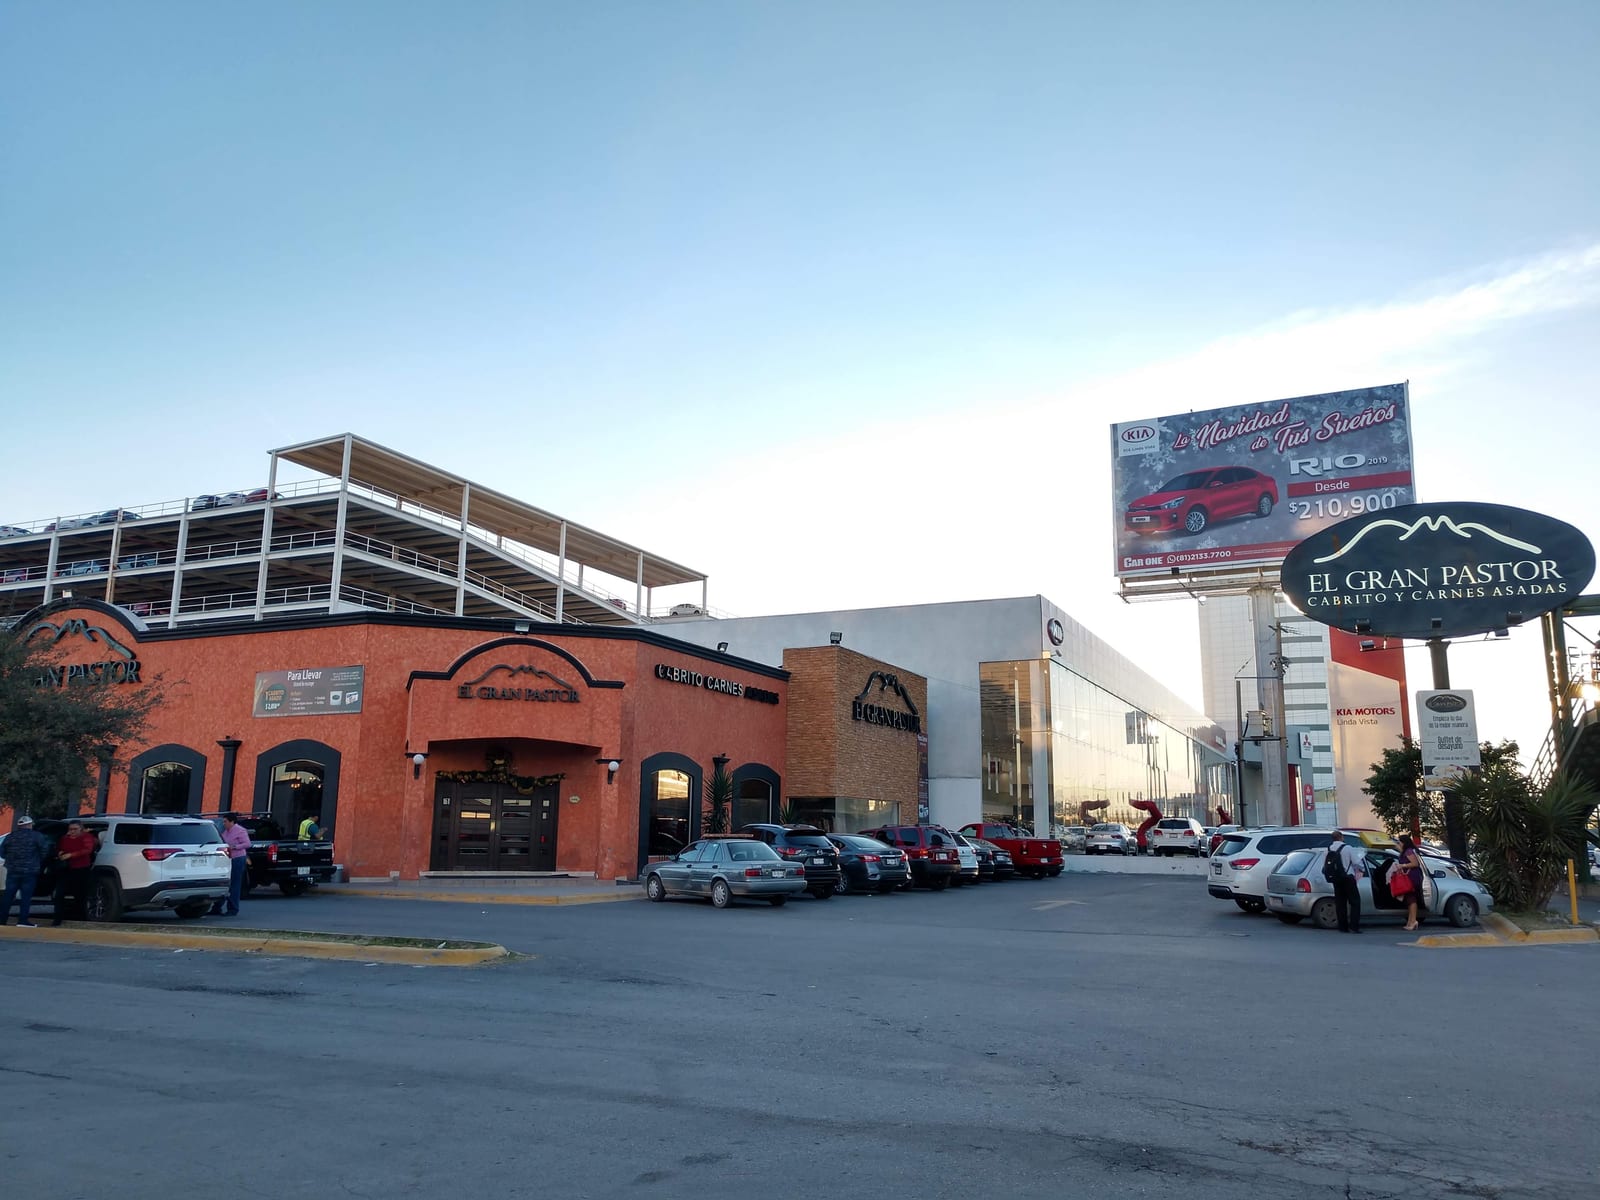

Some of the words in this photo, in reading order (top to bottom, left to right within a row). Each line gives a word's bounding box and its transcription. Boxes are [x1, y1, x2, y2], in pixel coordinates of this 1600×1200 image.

[1127, 429, 1149, 440] KIA
[1173, 433, 1191, 450] La
[1196, 402, 1290, 449] Navidad
[1251, 436, 1269, 452] de
[1274, 421, 1310, 452] Tus
[1315, 403, 1396, 442] Sueños
[1290, 453, 1366, 476] RIO
[1368, 456, 1388, 465] 2019
[1315, 480, 1350, 492] Desde
[1289, 493, 1397, 519] $210,900
[1308, 573, 1337, 593] EL
[1346, 567, 1429, 591] GRAN
[1441, 559, 1563, 586] PASTOR
[1307, 593, 1387, 607] CABRITO
[1394, 592, 1403, 602] Y
[1411, 587, 1485, 601] CARNES
[1492, 582, 1568, 597] ASADAS
[287, 671, 301, 681] Para
[302, 670, 322, 680] Llevar
[705, 676, 744, 697] CARNES
[457, 685, 474, 699] EL
[477, 686, 522, 700] GRAN
[525, 688, 581, 703] PASTOR
[1336, 708, 1352, 716] KIA
[1355, 707, 1396, 716] MOTORS
